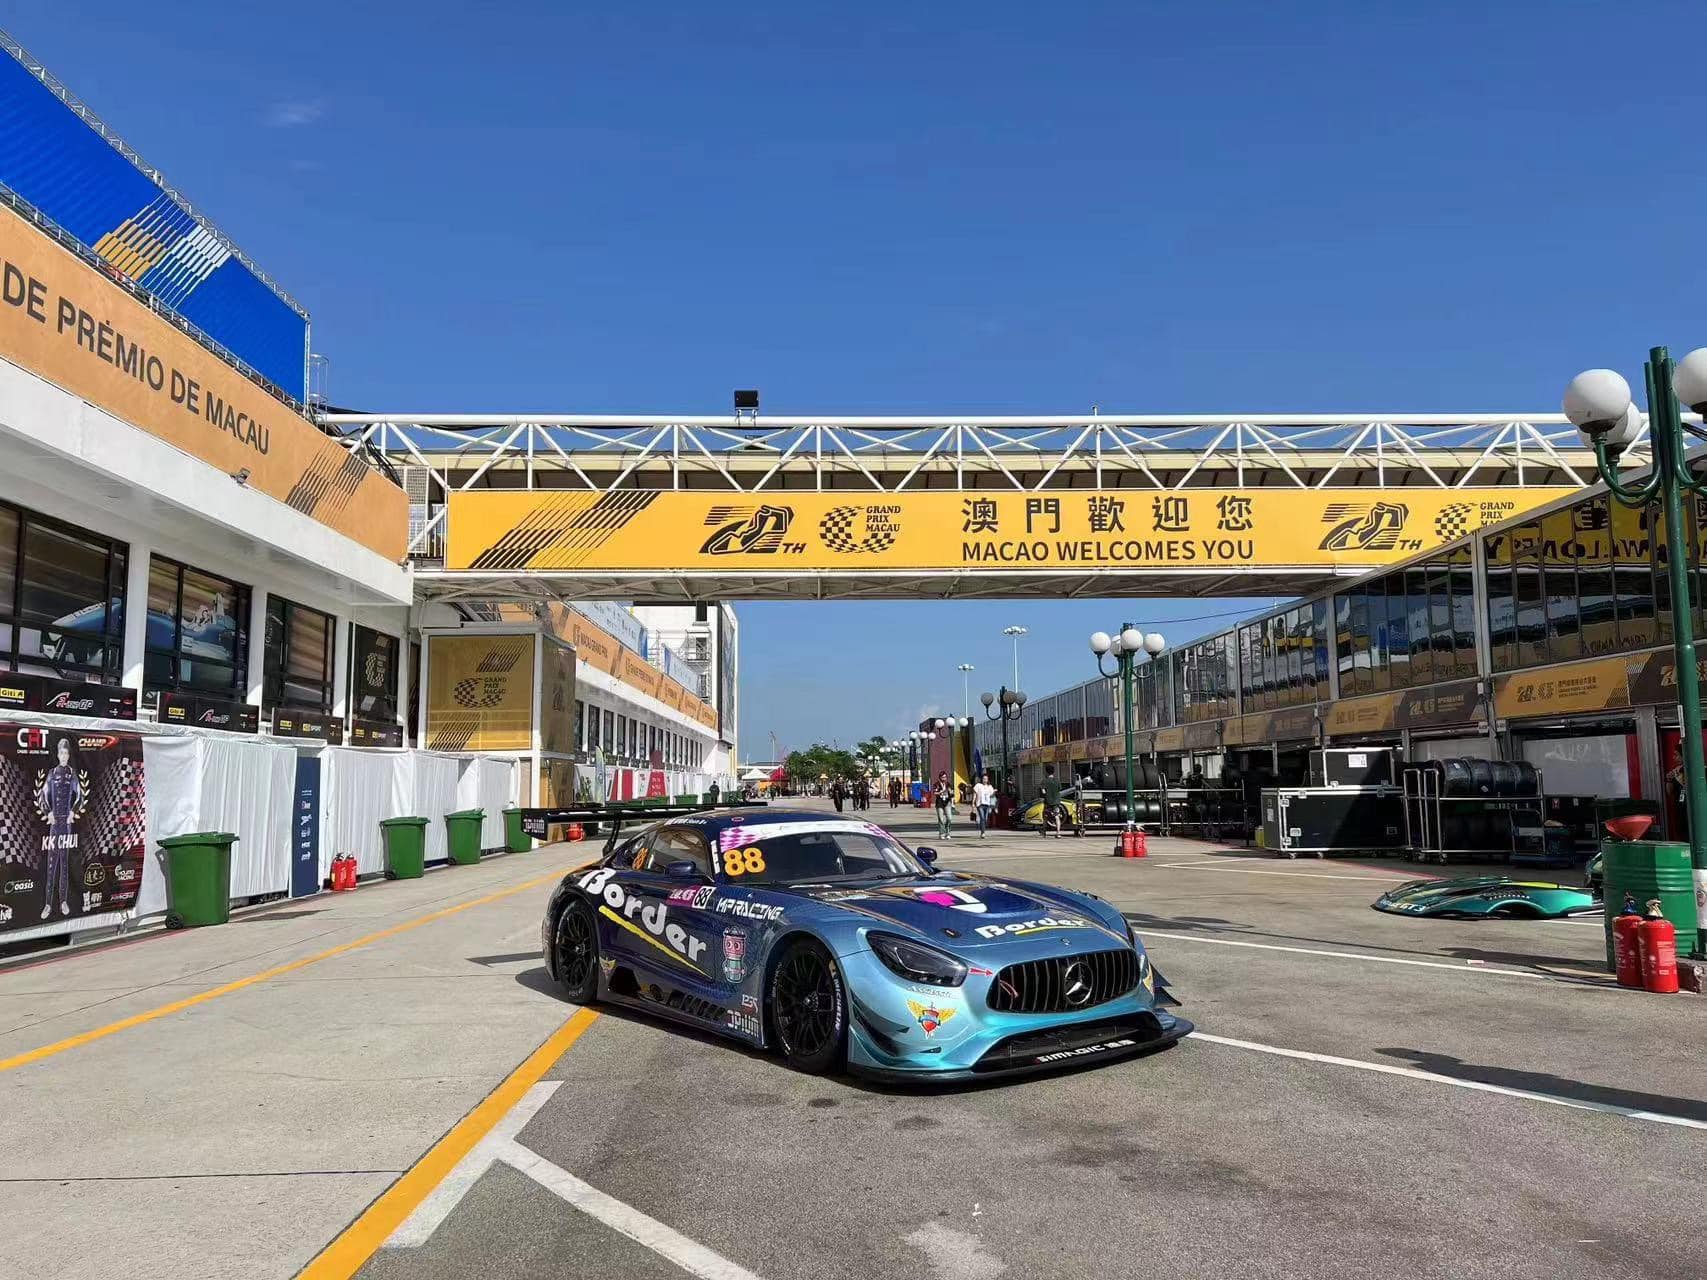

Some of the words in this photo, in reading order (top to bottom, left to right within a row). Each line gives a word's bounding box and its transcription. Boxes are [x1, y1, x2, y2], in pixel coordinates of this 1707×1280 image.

[0, 259, 47, 324] DE
[171, 368, 200, 414] DE
[205, 391, 269, 455] MACAU
[866, 505, 901, 514] GRAND
[960, 495, 1253, 534] 澳門歡迎您
[1480, 502, 1515, 510] GRAND
[1480, 511, 1503, 519] PRIX
[865, 523, 900, 532] MACAU
[866, 514, 889, 523] PRIX
[962, 541, 1049, 561] MACAO
[1056, 540, 1196, 561] WELCOMES
[1202, 540, 1254, 560] YOU
[41, 835, 55, 850] KK
[58, 834, 78, 848] CHUI
[723, 847, 766, 877] 88
[694, 888, 712, 907] 88
[578, 867, 707, 962] Border
[974, 917, 1085, 939] Border
